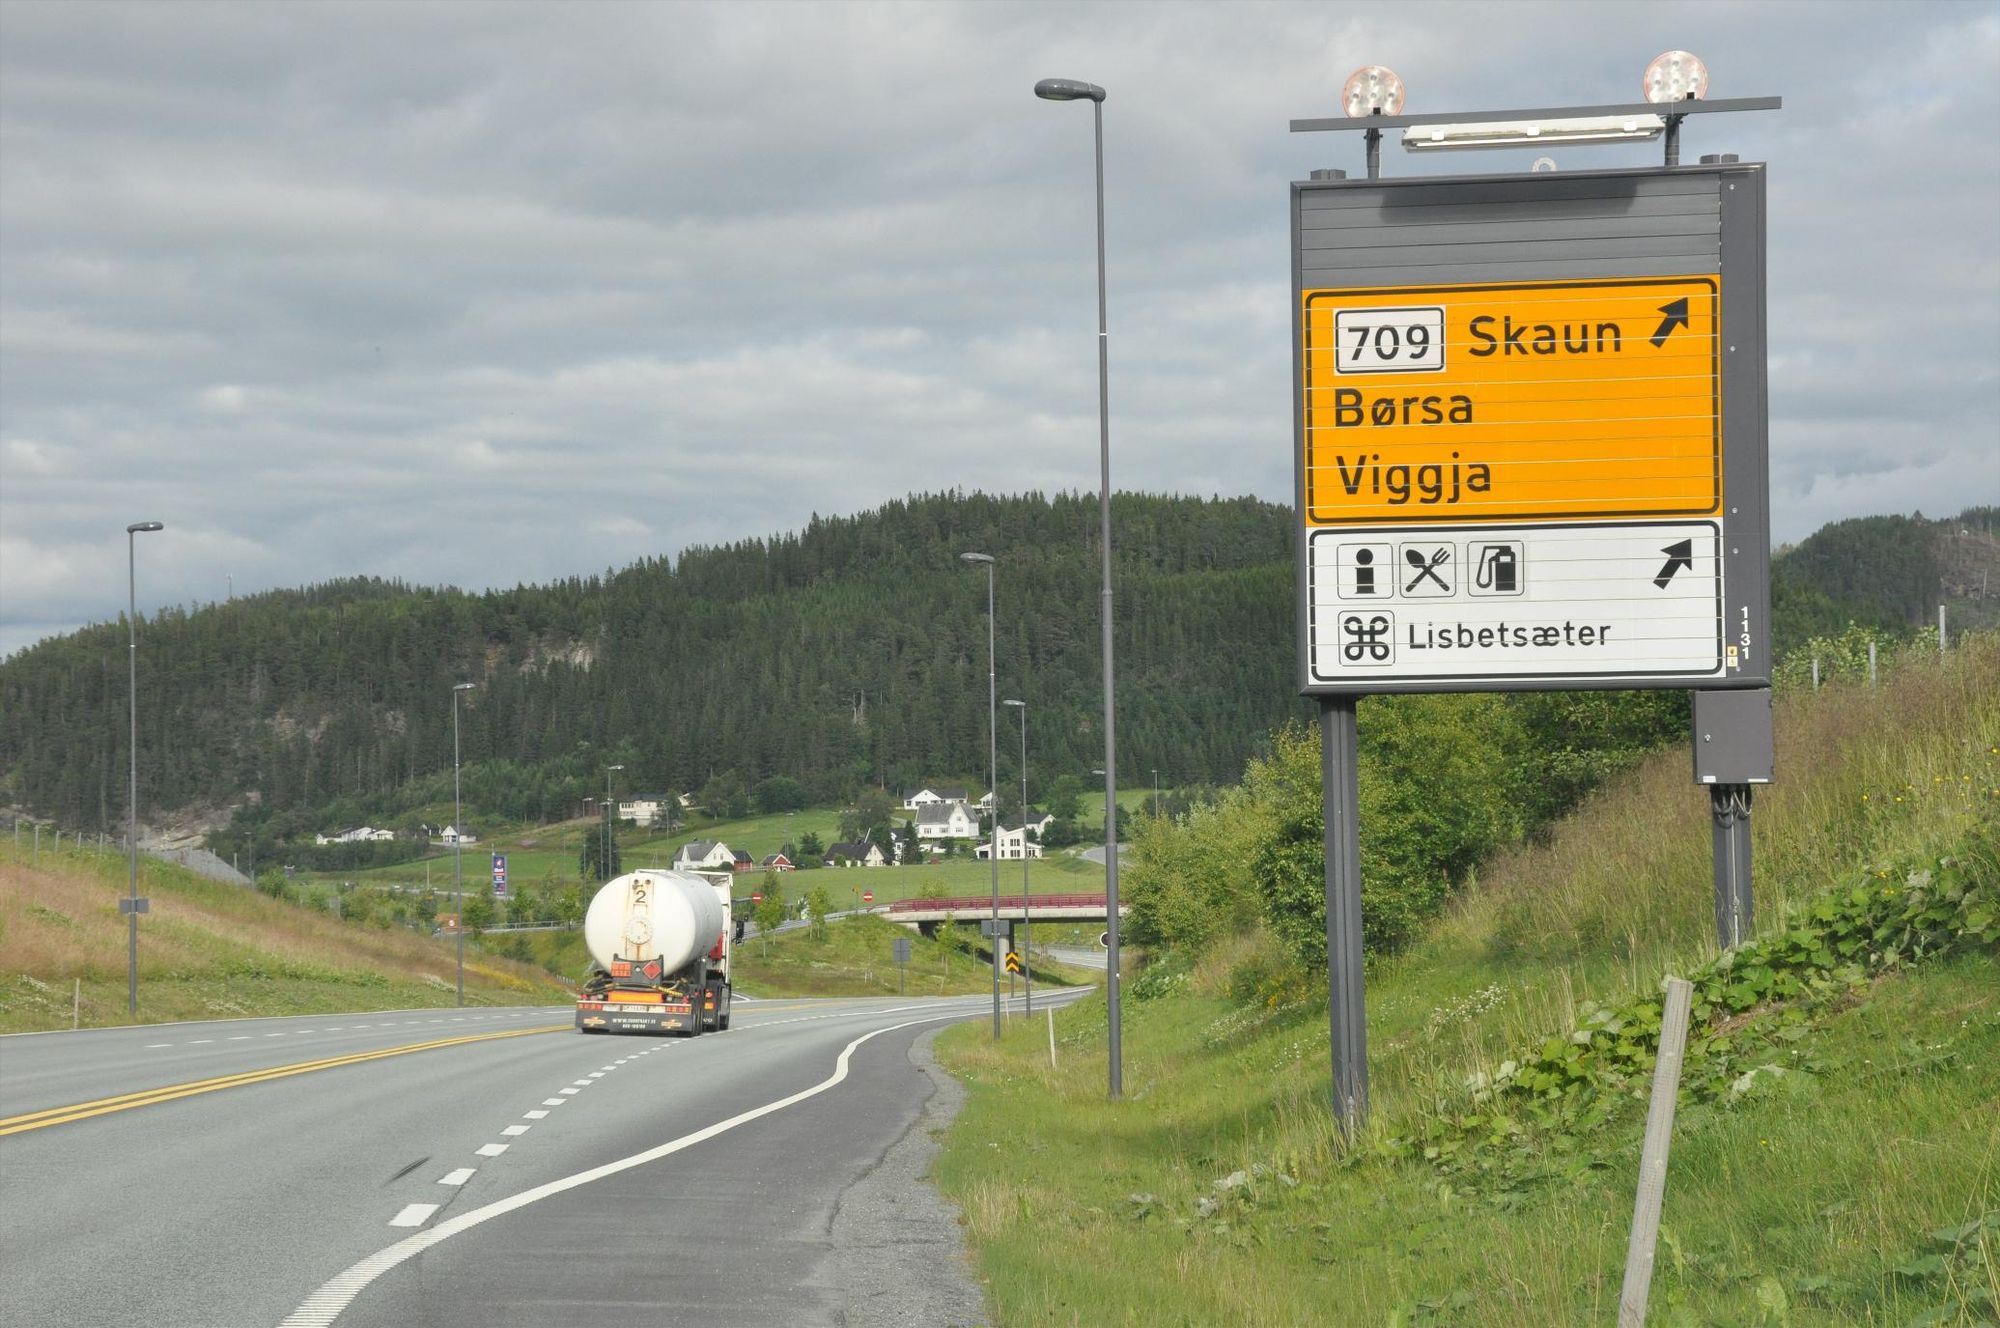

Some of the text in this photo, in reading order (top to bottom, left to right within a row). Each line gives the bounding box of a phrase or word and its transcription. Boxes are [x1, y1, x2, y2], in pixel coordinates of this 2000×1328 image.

[1348, 315, 1621, 360] 709 Skaun
[1335, 388, 1473, 427] Børsa
[1336, 451, 1491, 505] Viggja
[1409, 620, 1612, 649] Lisbetsæter
[635, 889, 646, 904] 2
